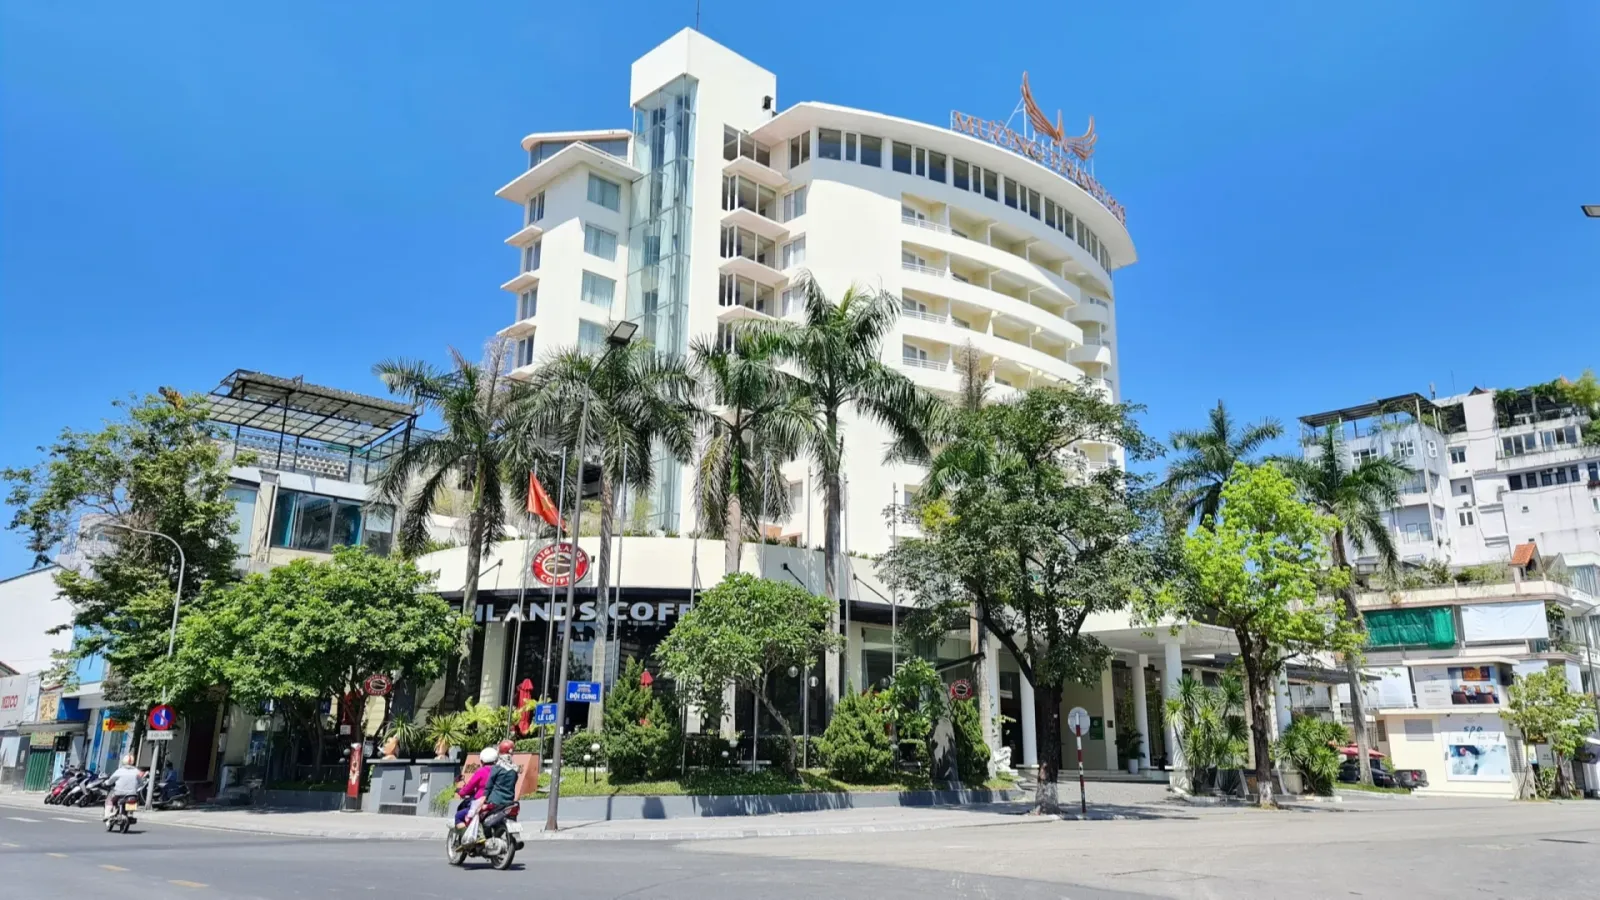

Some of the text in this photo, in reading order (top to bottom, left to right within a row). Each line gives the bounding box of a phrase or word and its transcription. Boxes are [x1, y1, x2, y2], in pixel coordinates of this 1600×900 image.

[535, 544, 586, 564] HIGHLADS
[608, 601, 694, 622] COFF
[1463, 725, 1484, 739] spa
